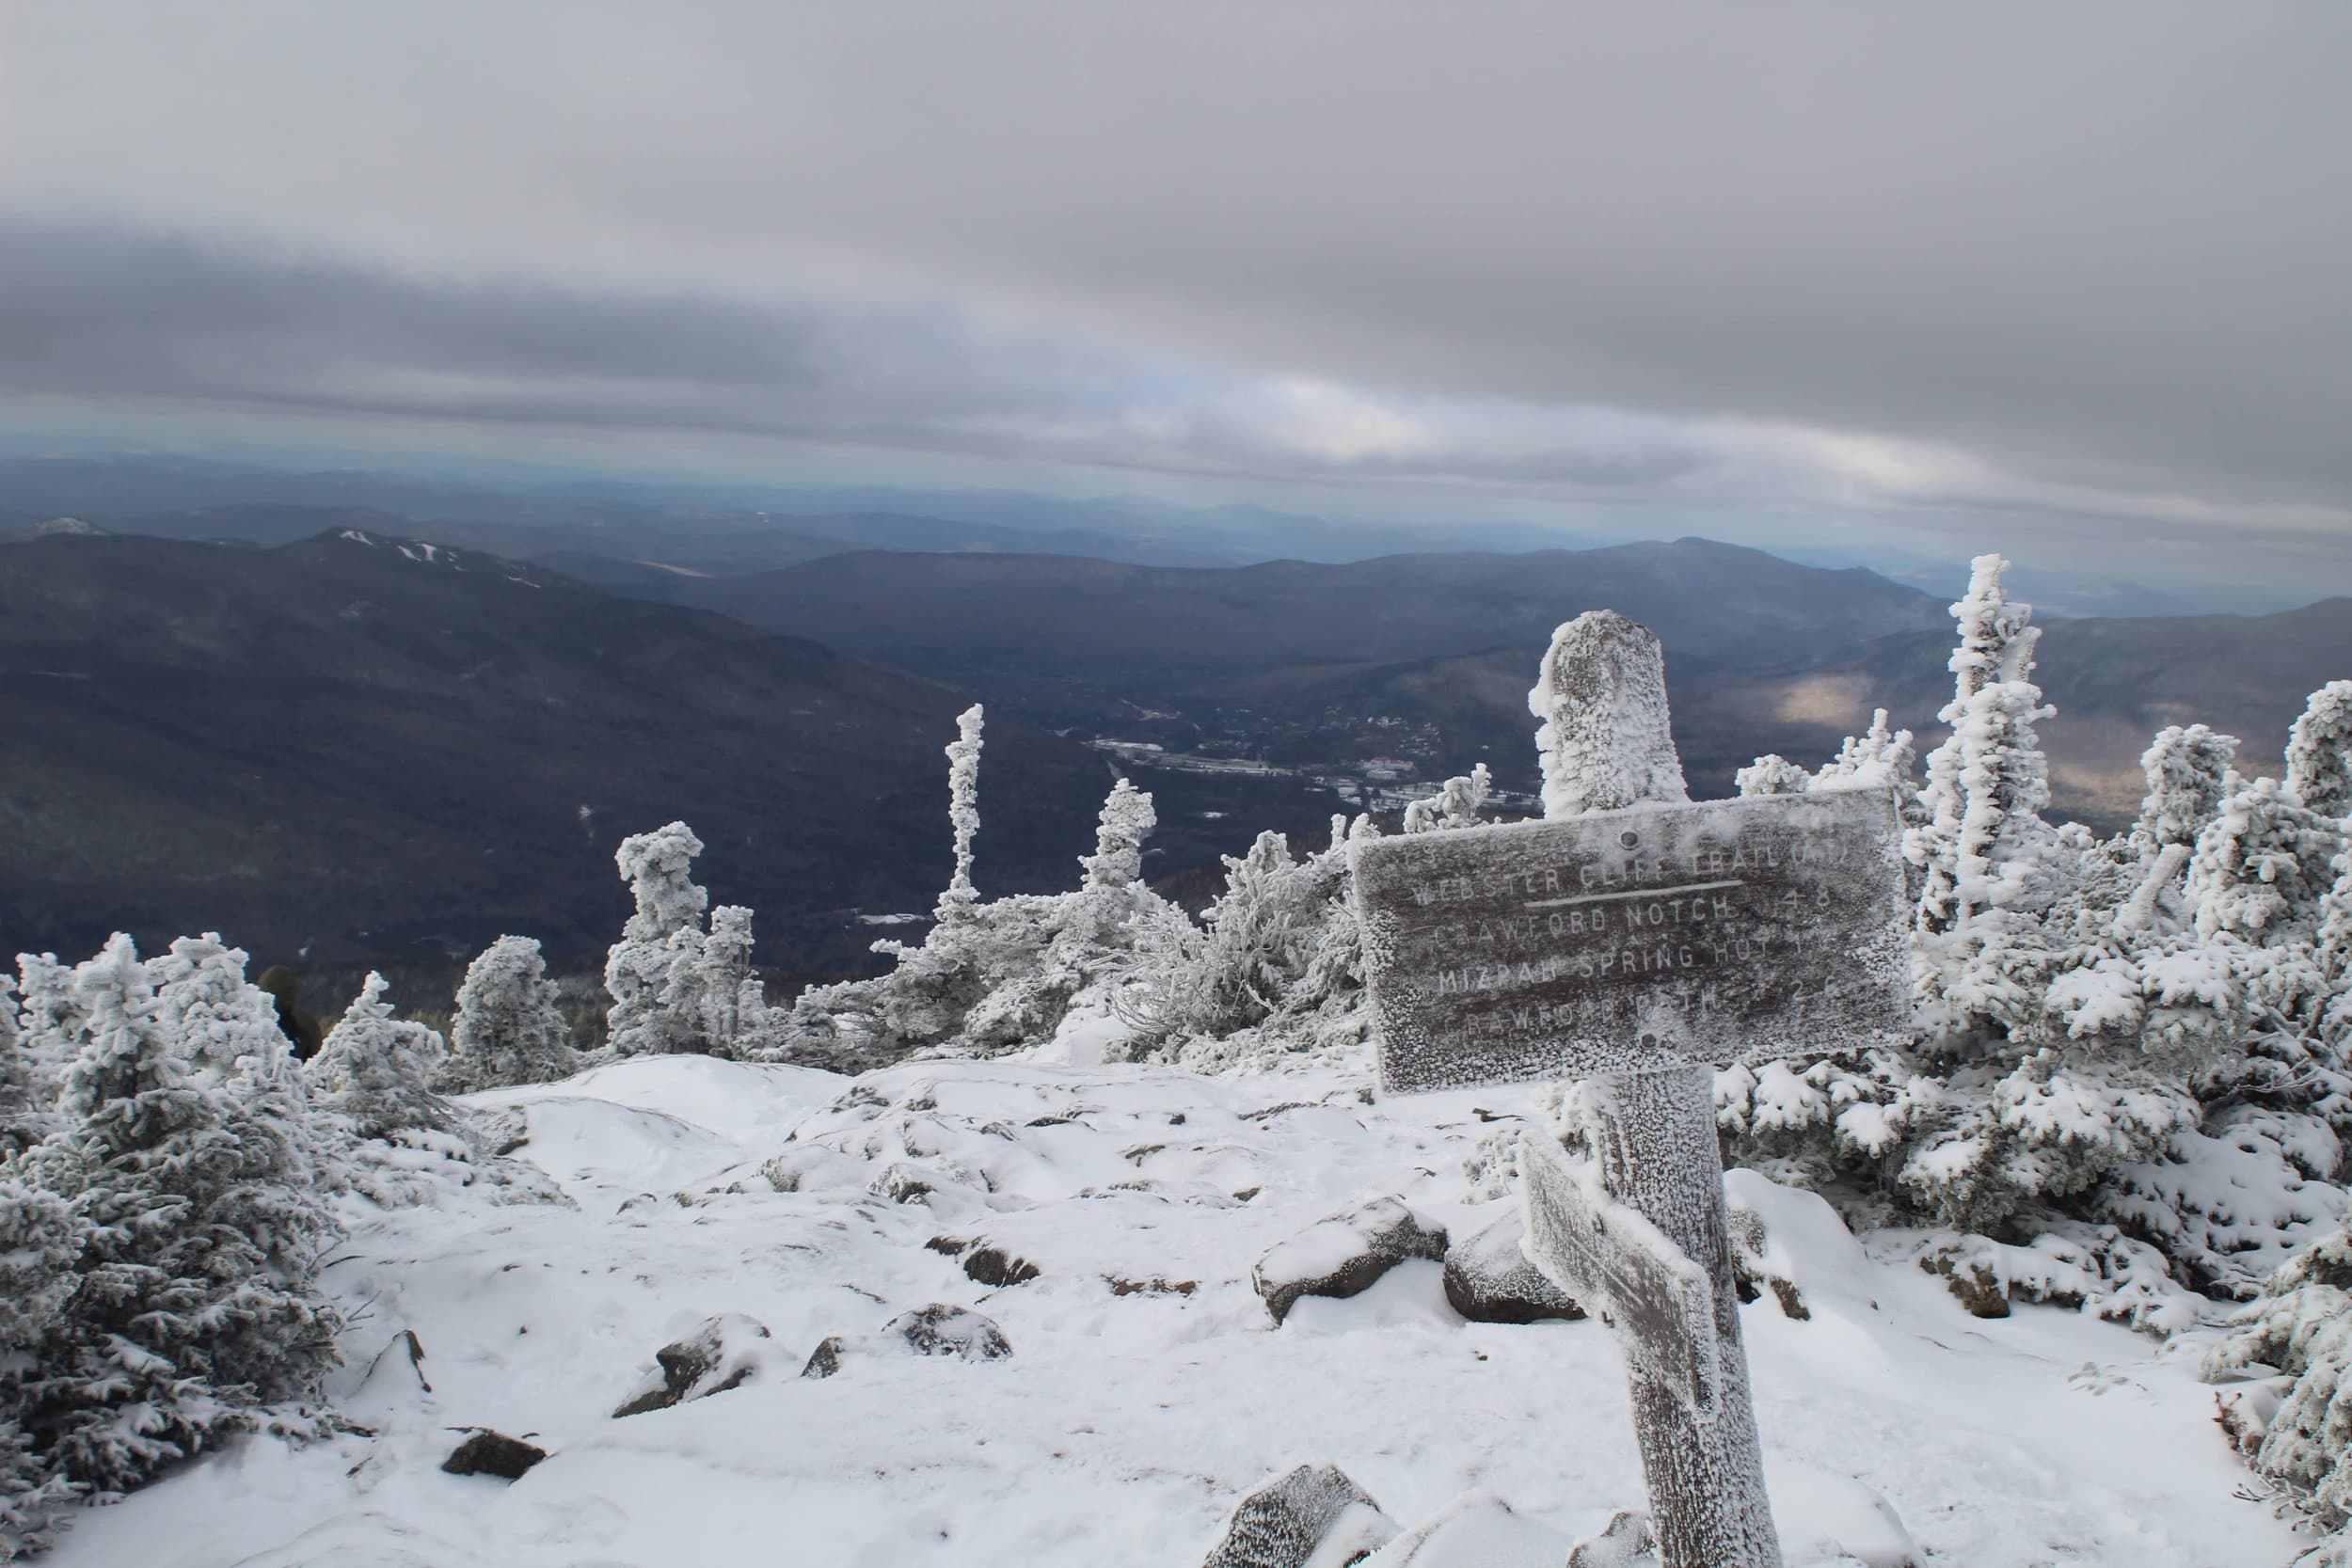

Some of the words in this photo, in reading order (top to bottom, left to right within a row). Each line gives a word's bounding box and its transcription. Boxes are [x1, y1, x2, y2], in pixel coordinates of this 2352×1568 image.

[1412, 869, 1560, 906] WEBSTER
[1691, 845, 1780, 875] TRAIL
[1433, 909, 1606, 947] CRAWFORD
[1627, 895, 1728, 927] NOTCH
[1438, 959, 1557, 993] MIZPAH
[1574, 944, 1693, 978] SPRING
[1713, 935, 1772, 964] HUT
[1635, 984, 1722, 1020] PTH
